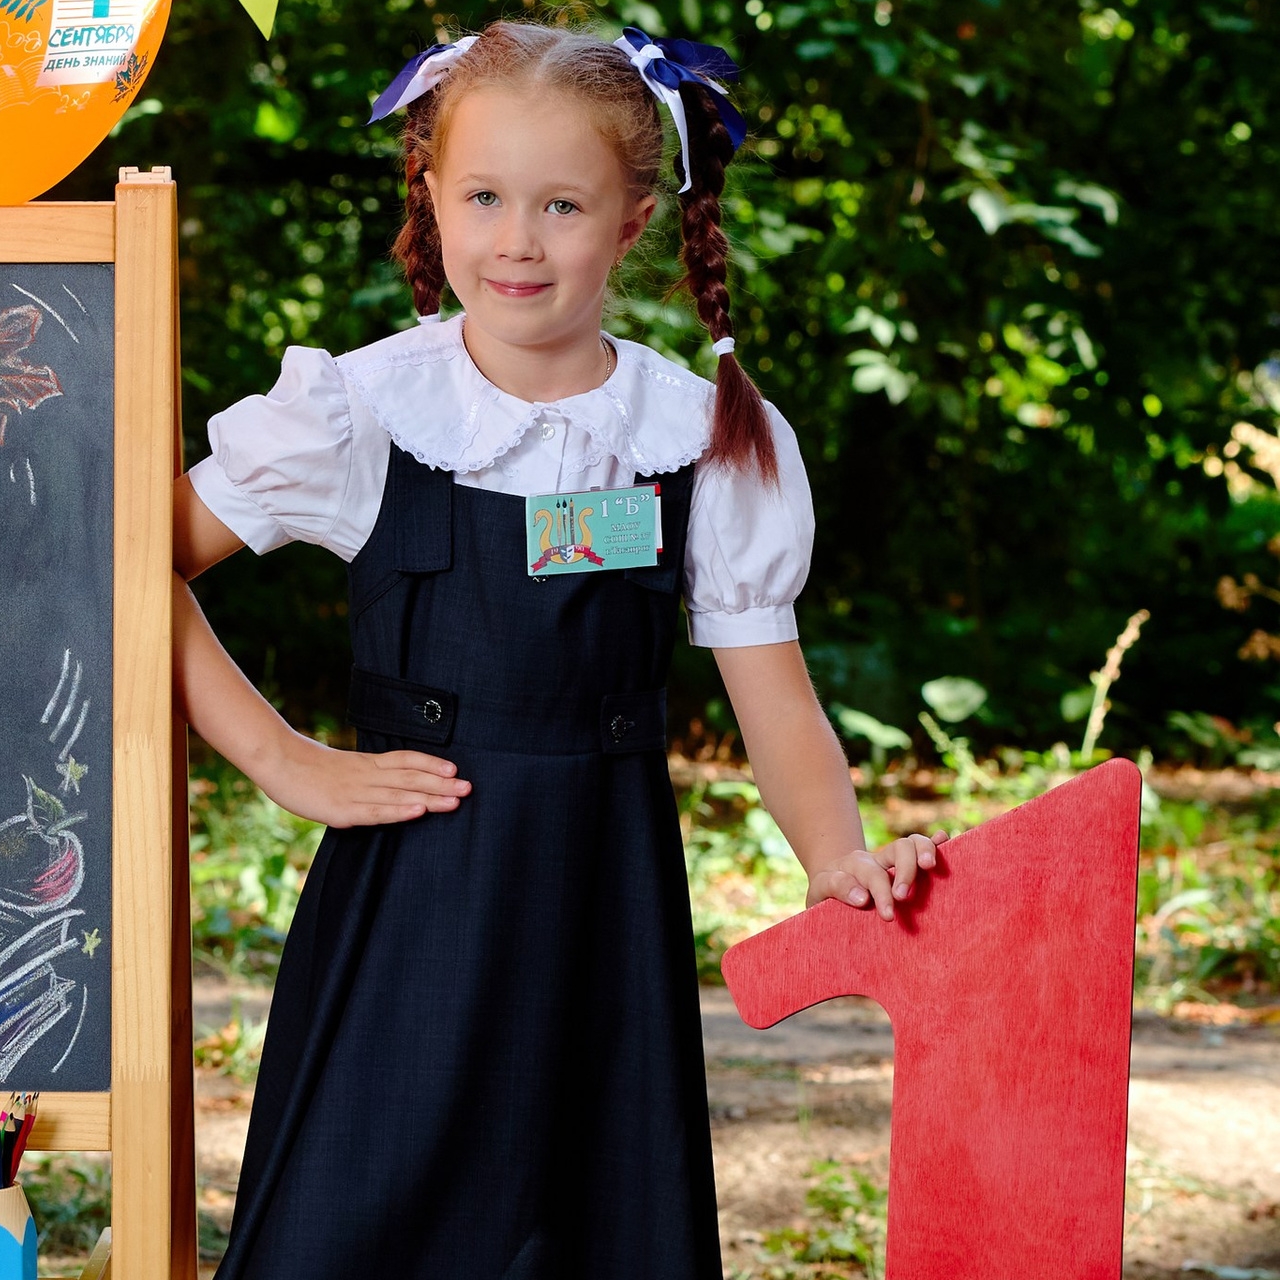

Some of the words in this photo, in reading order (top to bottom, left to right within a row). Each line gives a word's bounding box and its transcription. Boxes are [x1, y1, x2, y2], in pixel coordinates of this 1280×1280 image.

[47, 24, 135, 49] СЕНТЯБРЯ
[43, 57, 81, 73] ДЕНЬ
[83, 54, 127, 68] ЗНАНИЙ
[601, 498, 609, 518] 1
